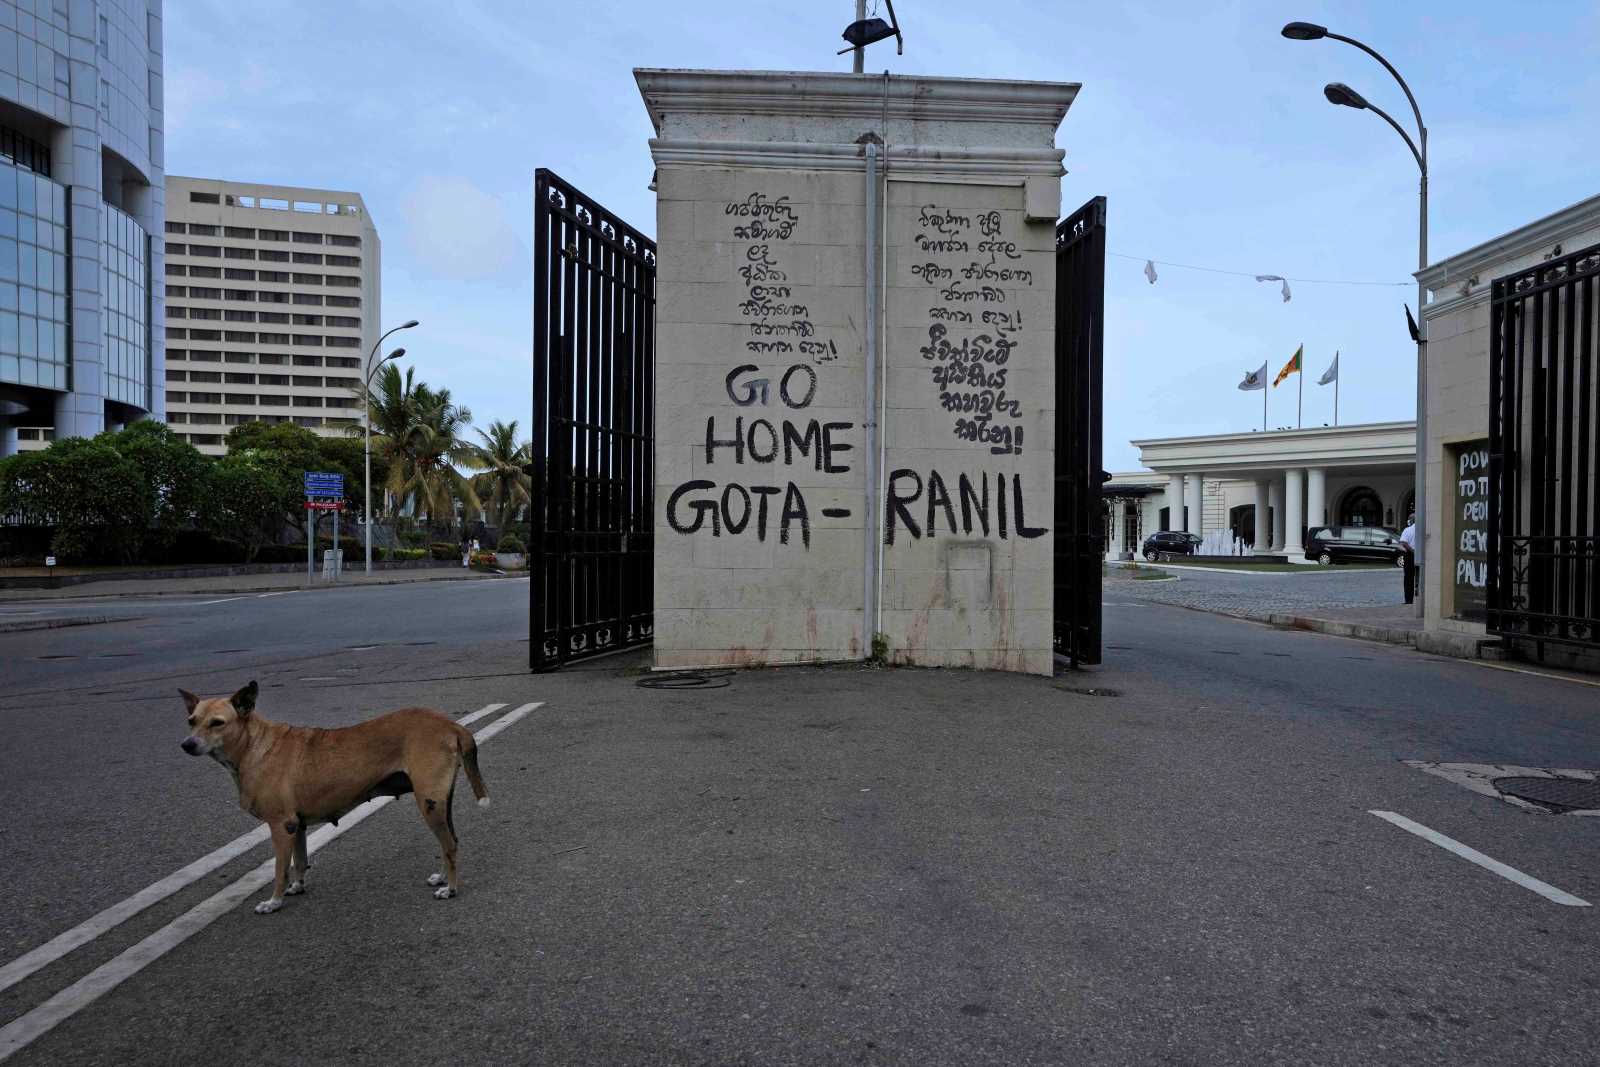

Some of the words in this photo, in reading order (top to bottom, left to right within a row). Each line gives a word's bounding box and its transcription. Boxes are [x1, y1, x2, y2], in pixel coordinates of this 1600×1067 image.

[725, 364, 817, 410] GO
[706, 416, 854, 474] HOME
[666, 479, 811, 552] GOTA
[884, 469, 1049, 546] RANIL
[1459, 479, 1475, 497] TO
[1463, 501, 1488, 521] PEO
